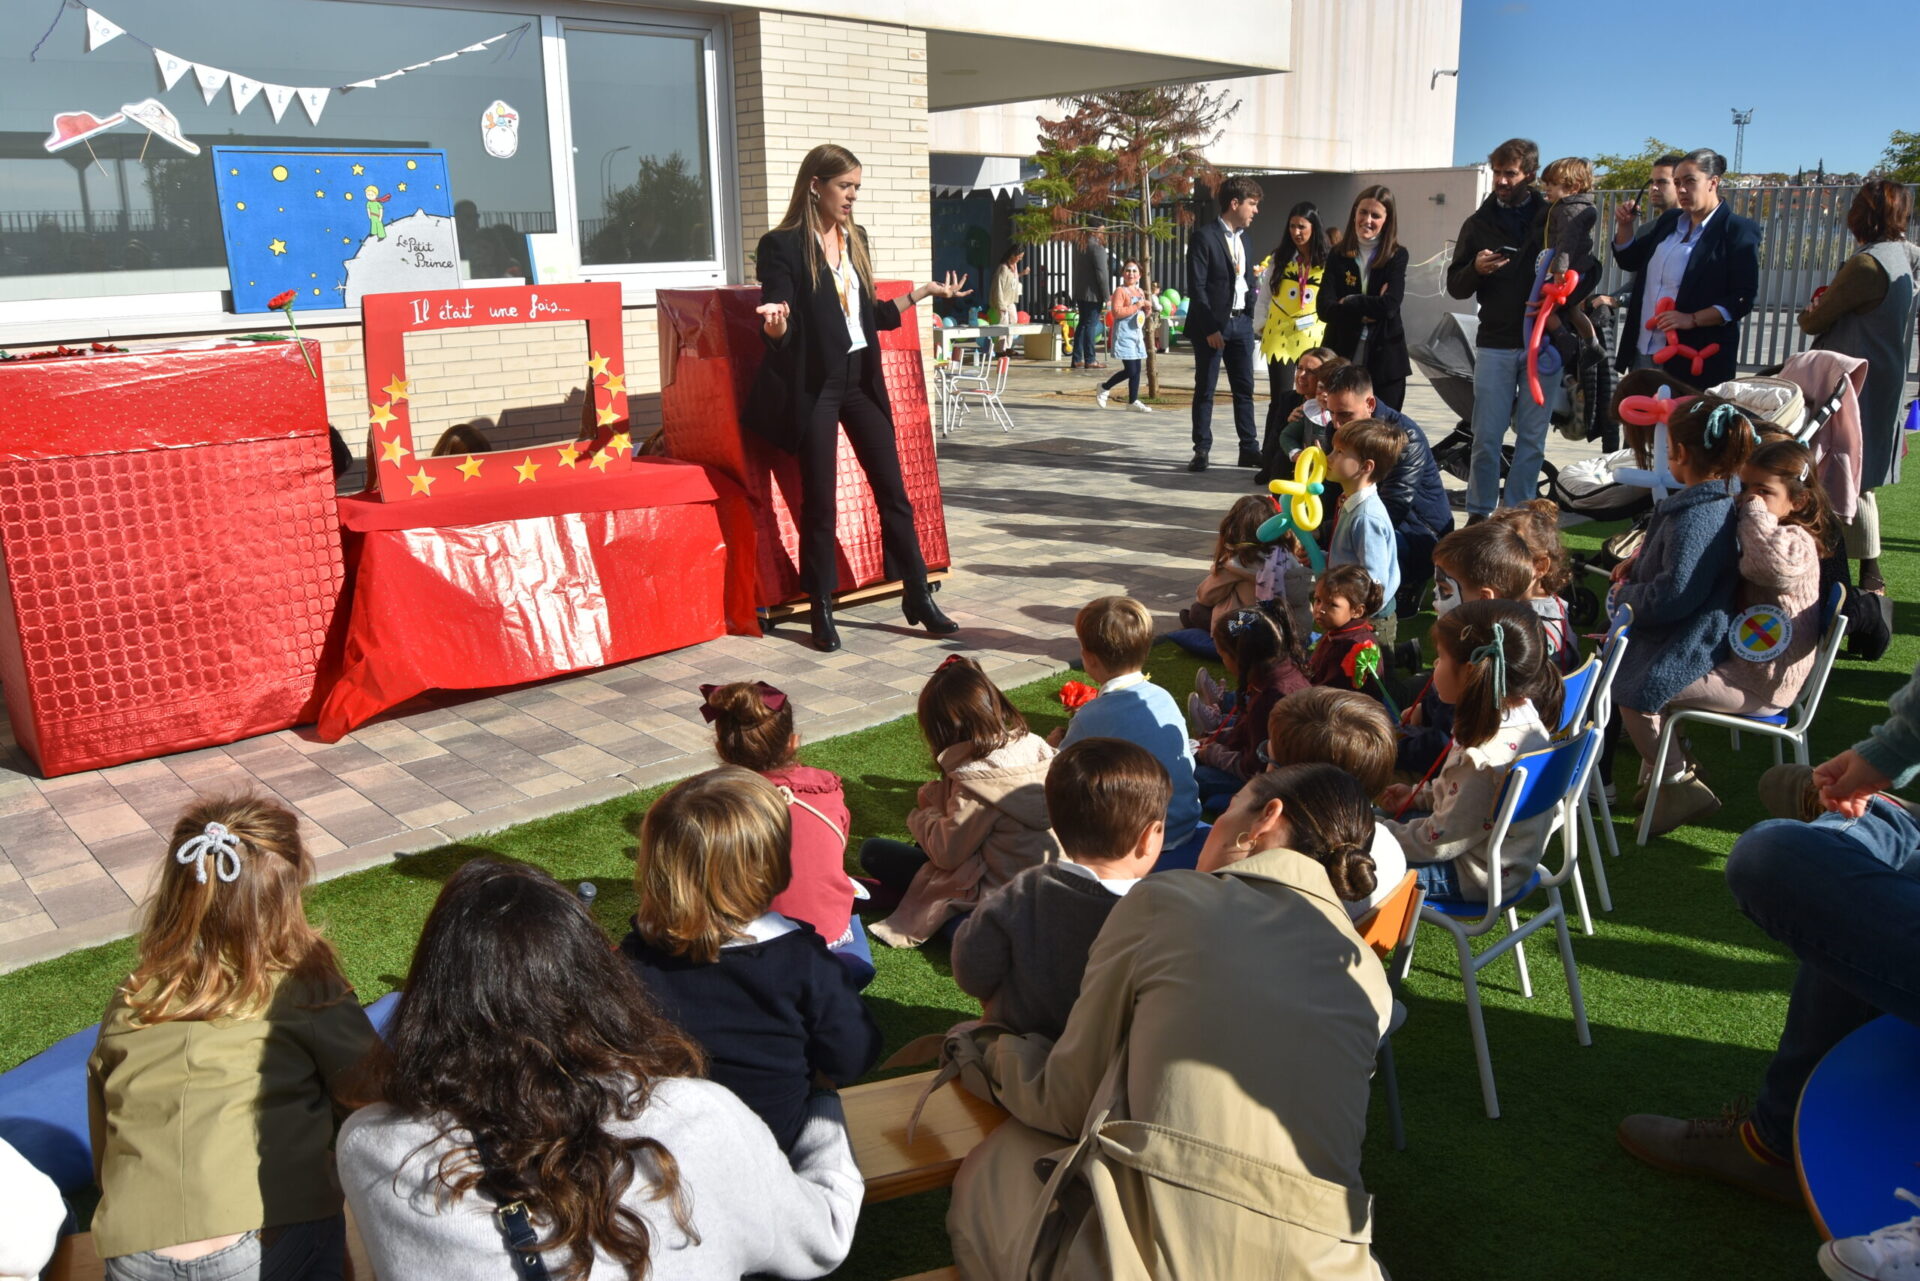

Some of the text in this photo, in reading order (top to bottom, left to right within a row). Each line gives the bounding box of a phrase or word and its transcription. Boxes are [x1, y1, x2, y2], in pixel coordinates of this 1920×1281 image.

[396, 235, 434, 252] Le Petit
[414, 252, 454, 268] Prince
[410, 299, 430, 325] Il
[489, 306, 519, 318] une
